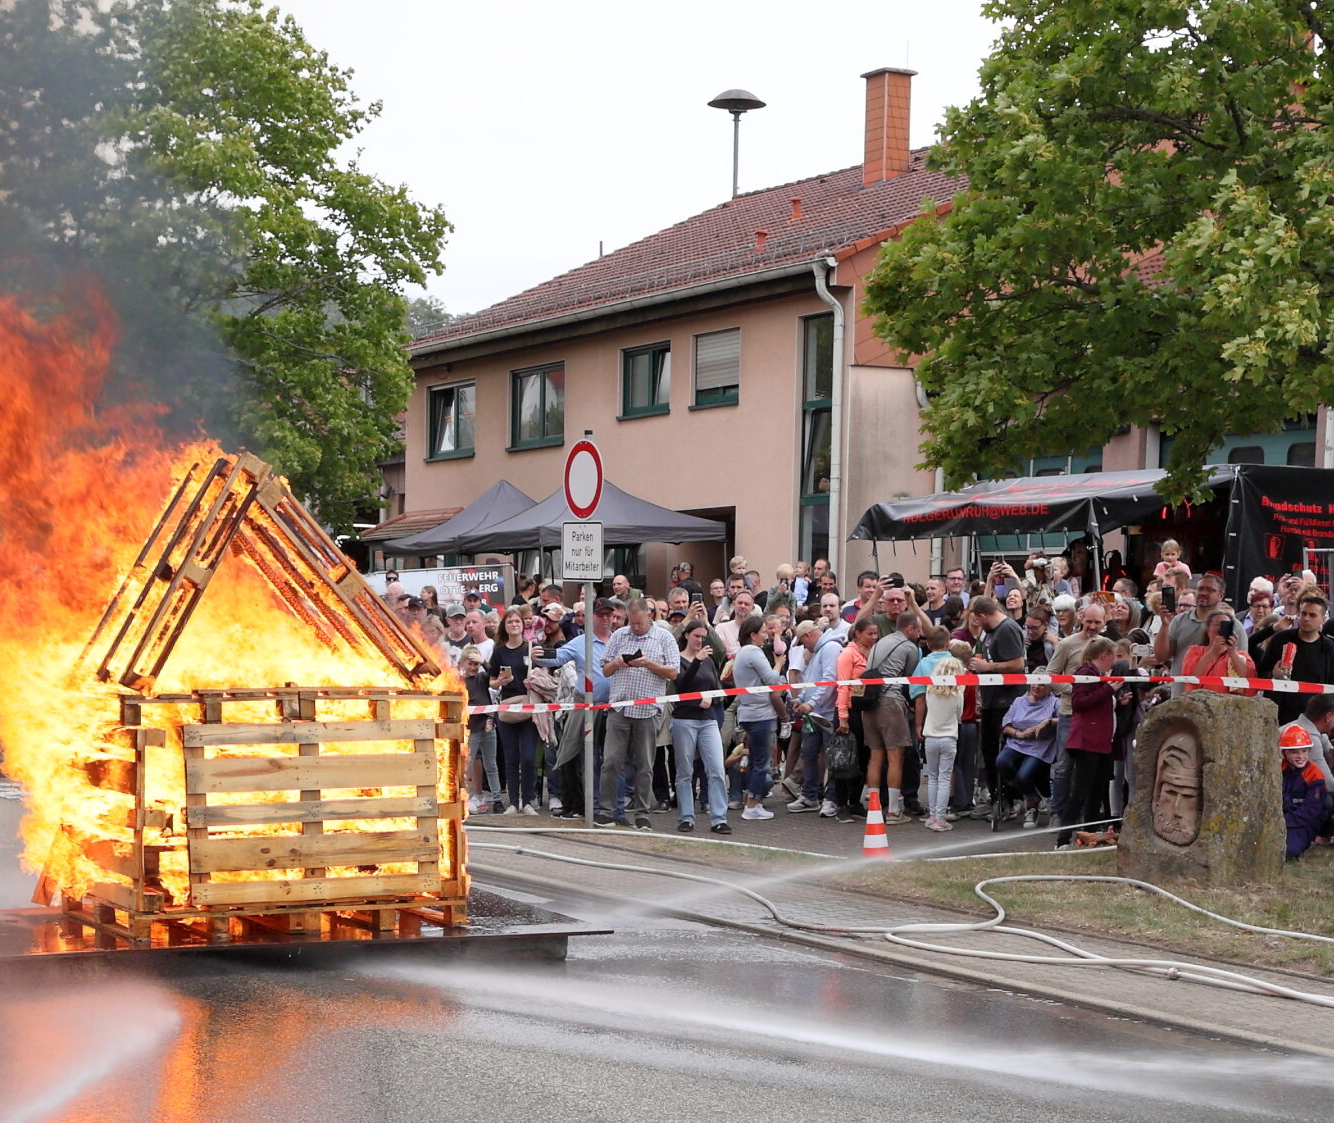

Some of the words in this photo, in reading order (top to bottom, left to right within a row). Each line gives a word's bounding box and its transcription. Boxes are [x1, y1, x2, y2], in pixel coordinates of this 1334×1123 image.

[571, 531, 594, 541] Parken
[571, 548, 582, 556] nur
[584, 546, 594, 556] für
[565, 561, 600, 572] Mitarbeiter
[437, 571, 499, 584] FEUERWEHR
[440, 583, 499, 595] OTTEERG
